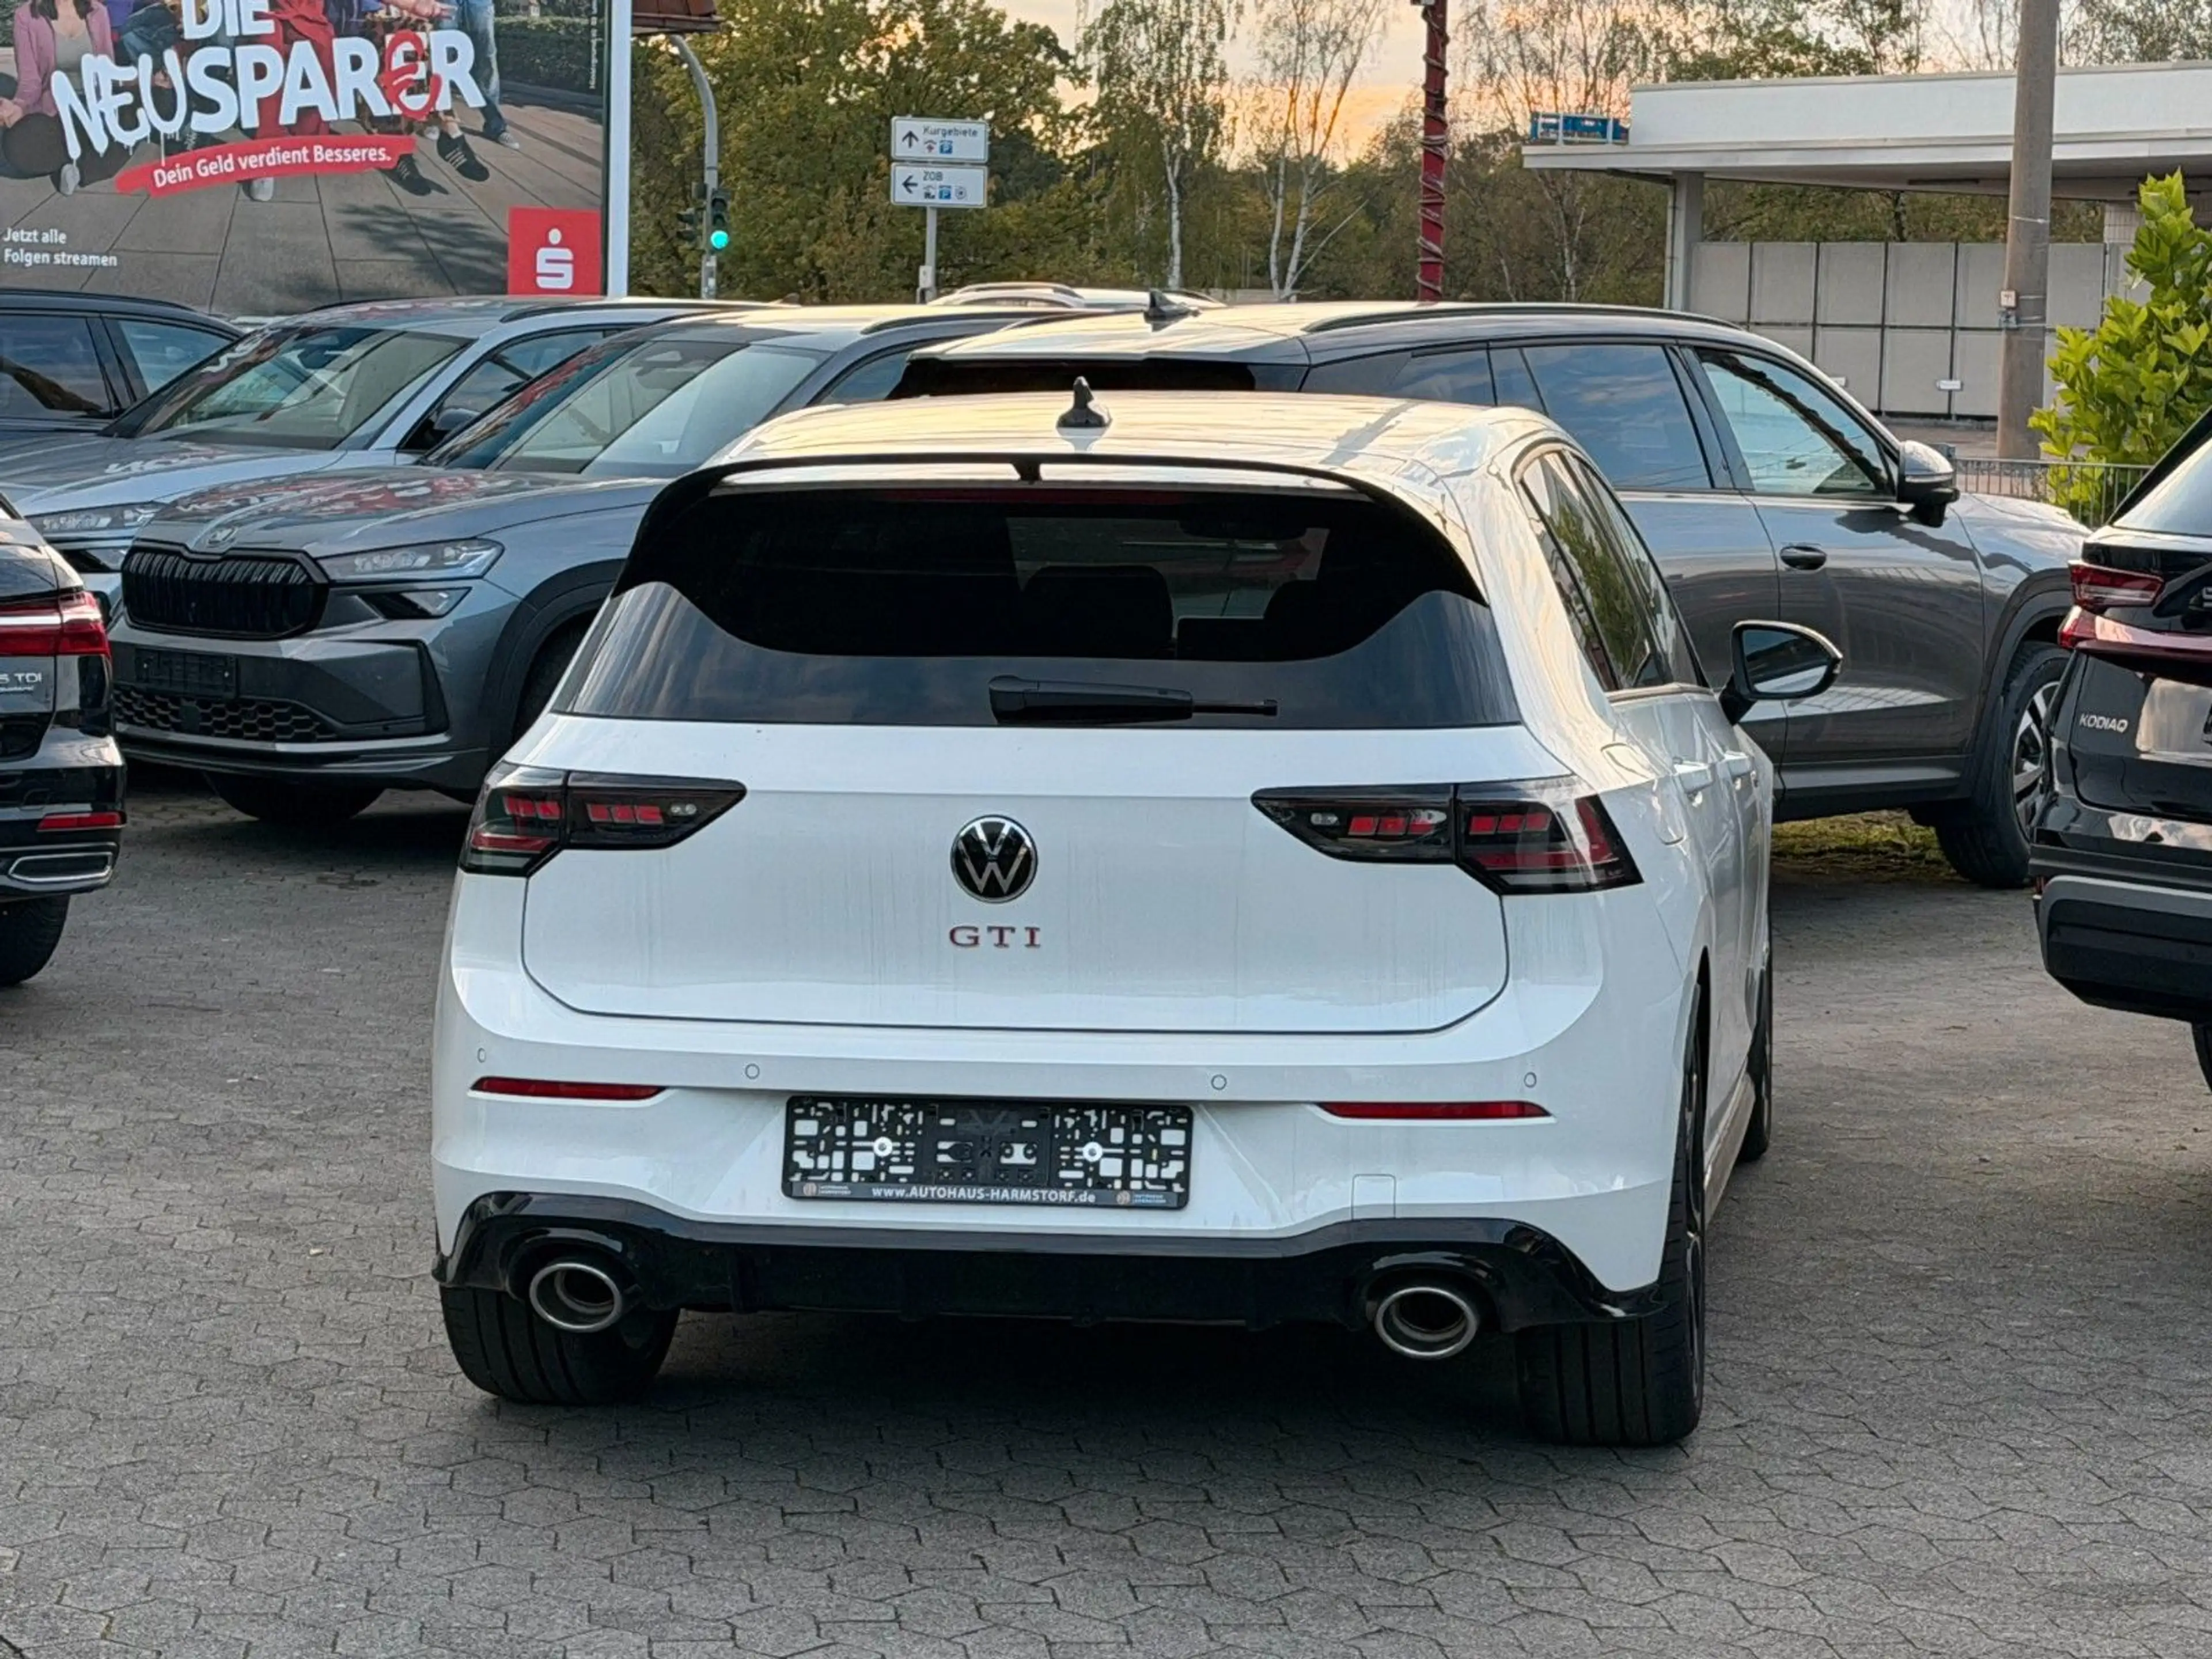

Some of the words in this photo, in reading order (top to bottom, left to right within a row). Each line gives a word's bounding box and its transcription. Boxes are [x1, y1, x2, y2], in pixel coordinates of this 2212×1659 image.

[181, 0, 275, 40] DIE
[922, 126, 978, 138] Kurgebiete
[153, 165, 194, 188] Dein
[196, 155, 234, 177] Geld
[237, 144, 311, 171] verdient
[313, 145, 392, 164] Besseres.
[923, 170, 943, 181] ZOB
[3, 228, 39, 243] Jetzt
[41, 229, 67, 244] alle
[4, 248, 51, 267] Folgen
[53, 251, 118, 266] streamen
[14, 672, 42, 683] TDI
[2079, 713, 2128, 733] KODIAQ
[949, 925, 1041, 948] GTI
[872, 1185, 1096, 1204] www.AUTOHAUS-HARMSTORF.de
